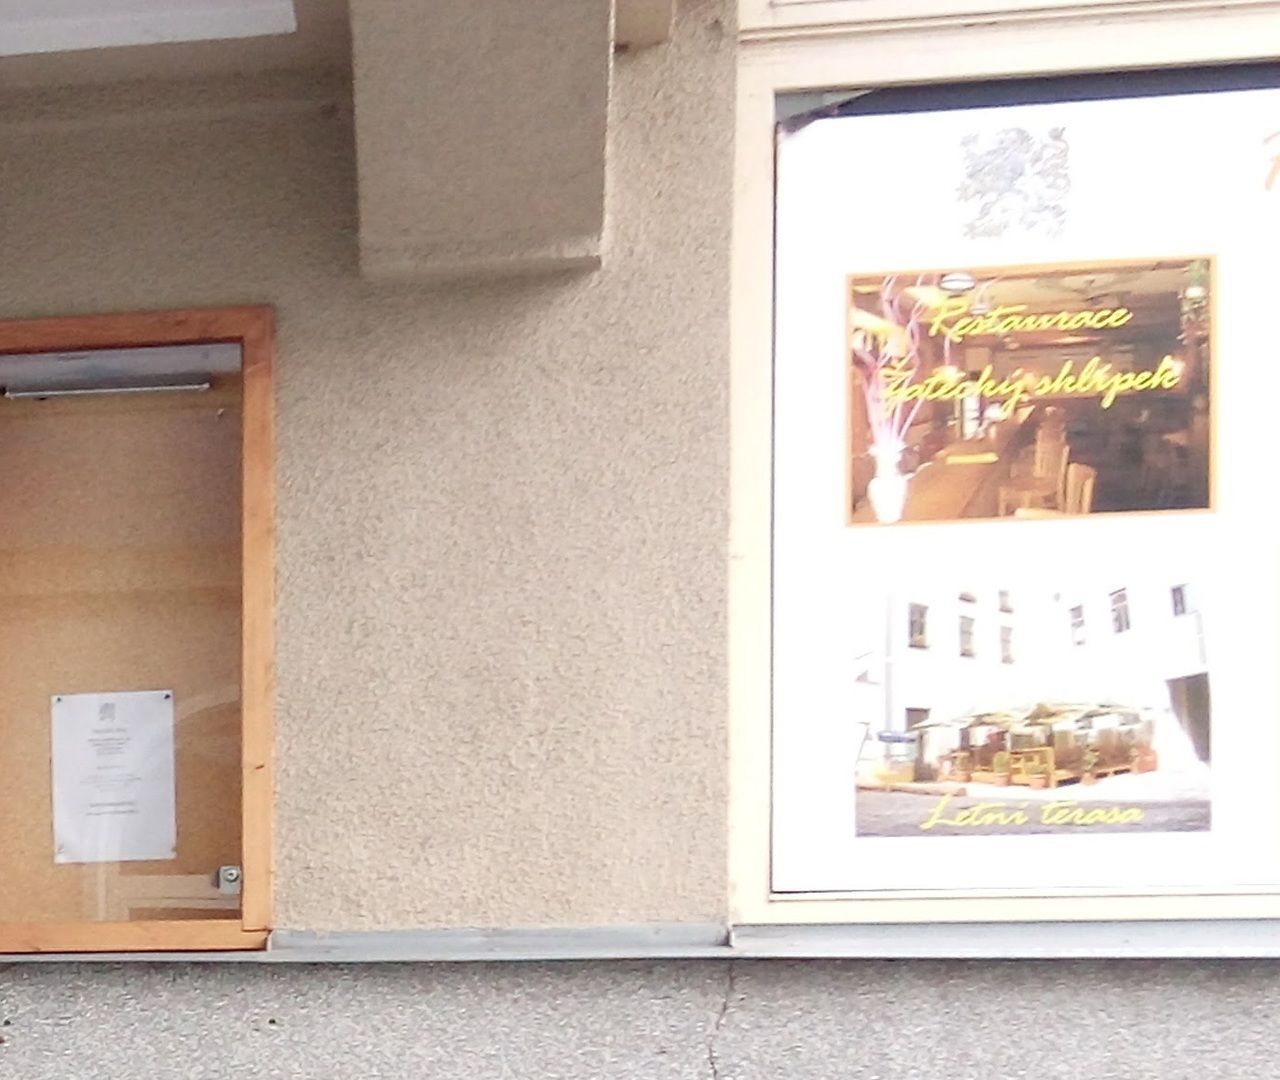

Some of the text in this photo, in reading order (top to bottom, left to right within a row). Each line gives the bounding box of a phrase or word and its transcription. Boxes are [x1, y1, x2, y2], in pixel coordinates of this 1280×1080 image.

[927, 304, 1133, 342] Restaurace
[1034, 354, 1181, 409] sklípek
[920, 793, 1146, 831] Letní terasa
